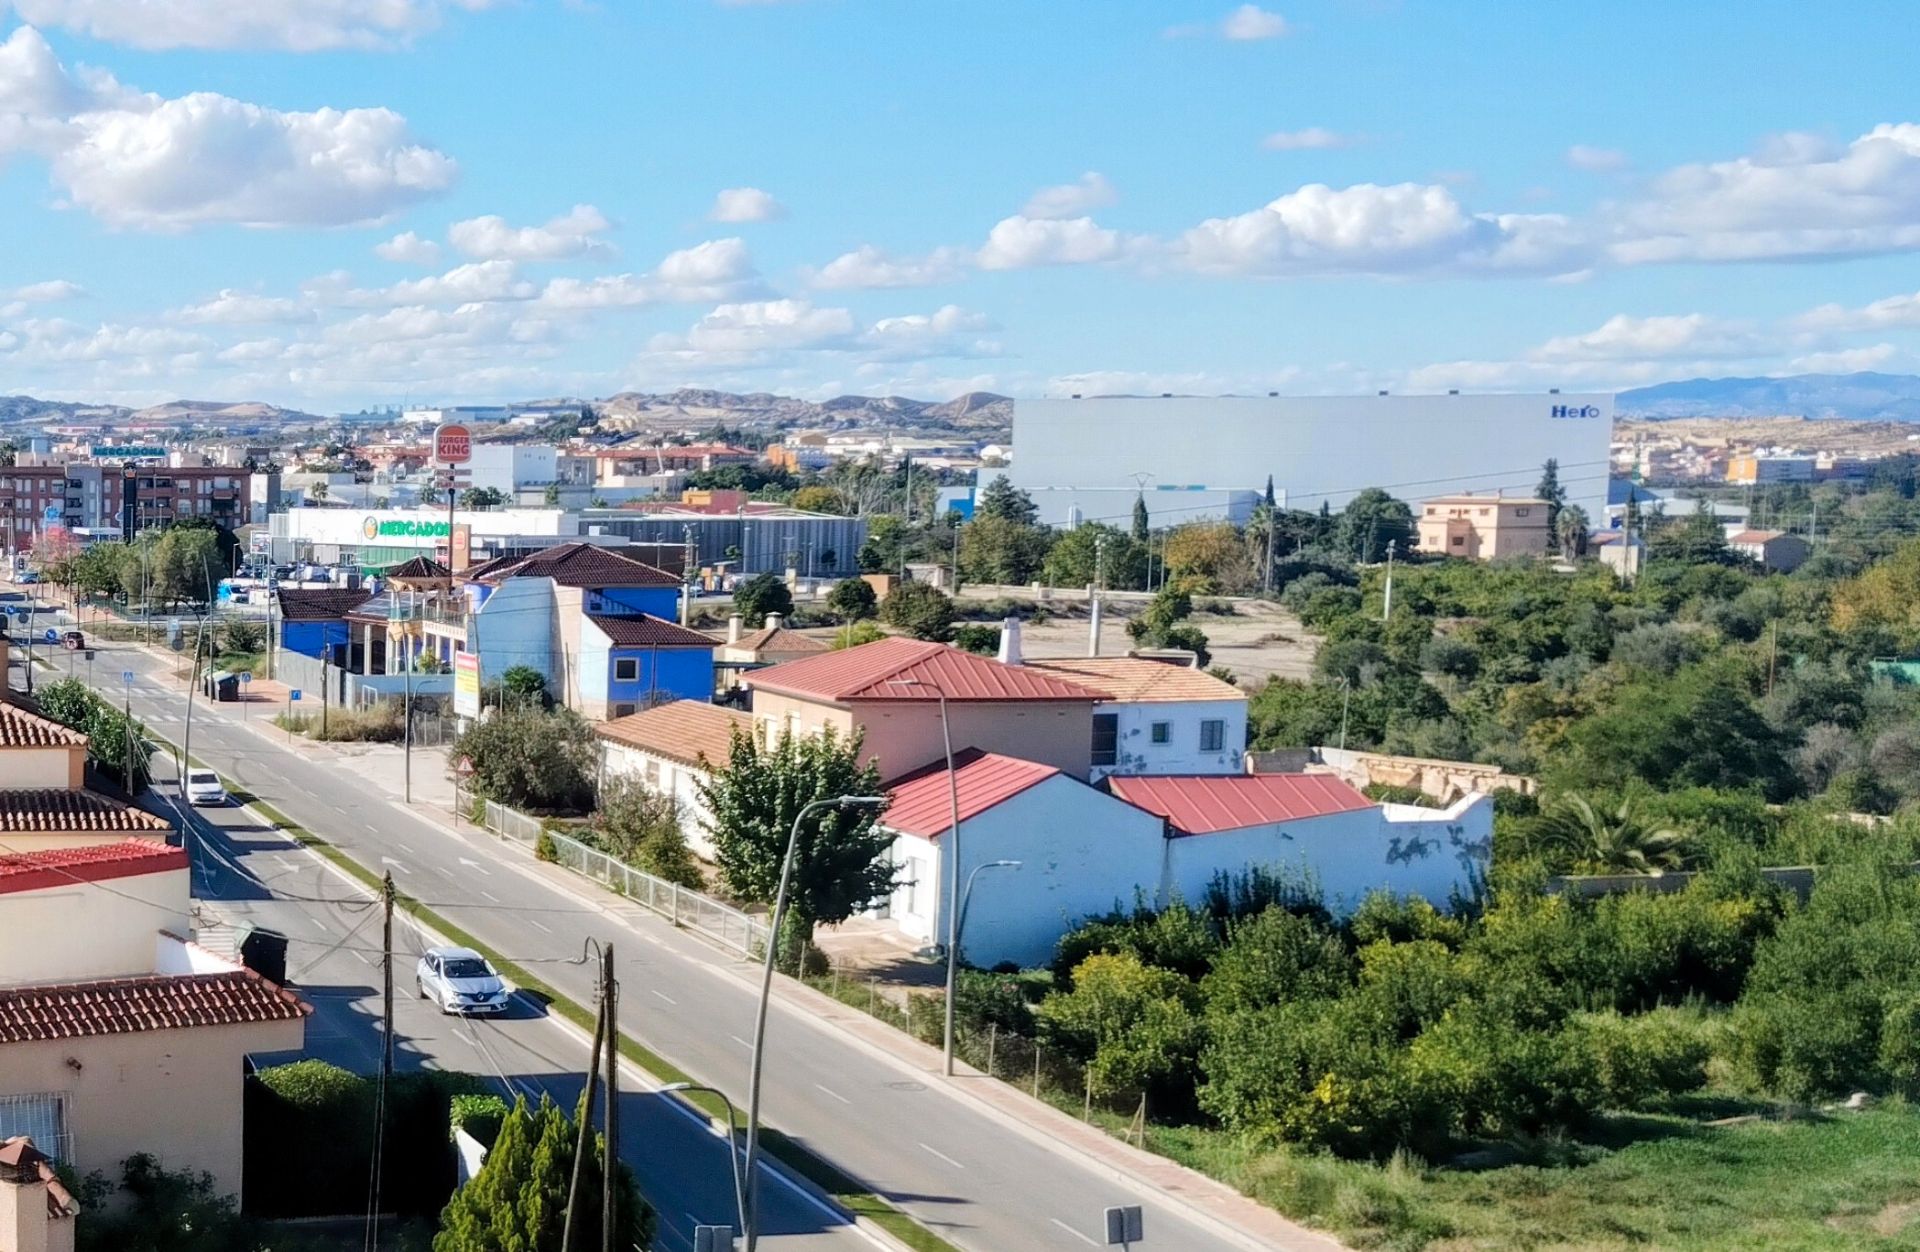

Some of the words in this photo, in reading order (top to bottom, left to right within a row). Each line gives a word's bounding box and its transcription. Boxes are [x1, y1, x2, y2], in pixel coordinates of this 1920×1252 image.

[1552, 405, 1600, 418] Hero
[438, 436, 470, 444] BURGER
[93, 447, 166, 456] MERCADONA
[438, 445, 470, 455] KING
